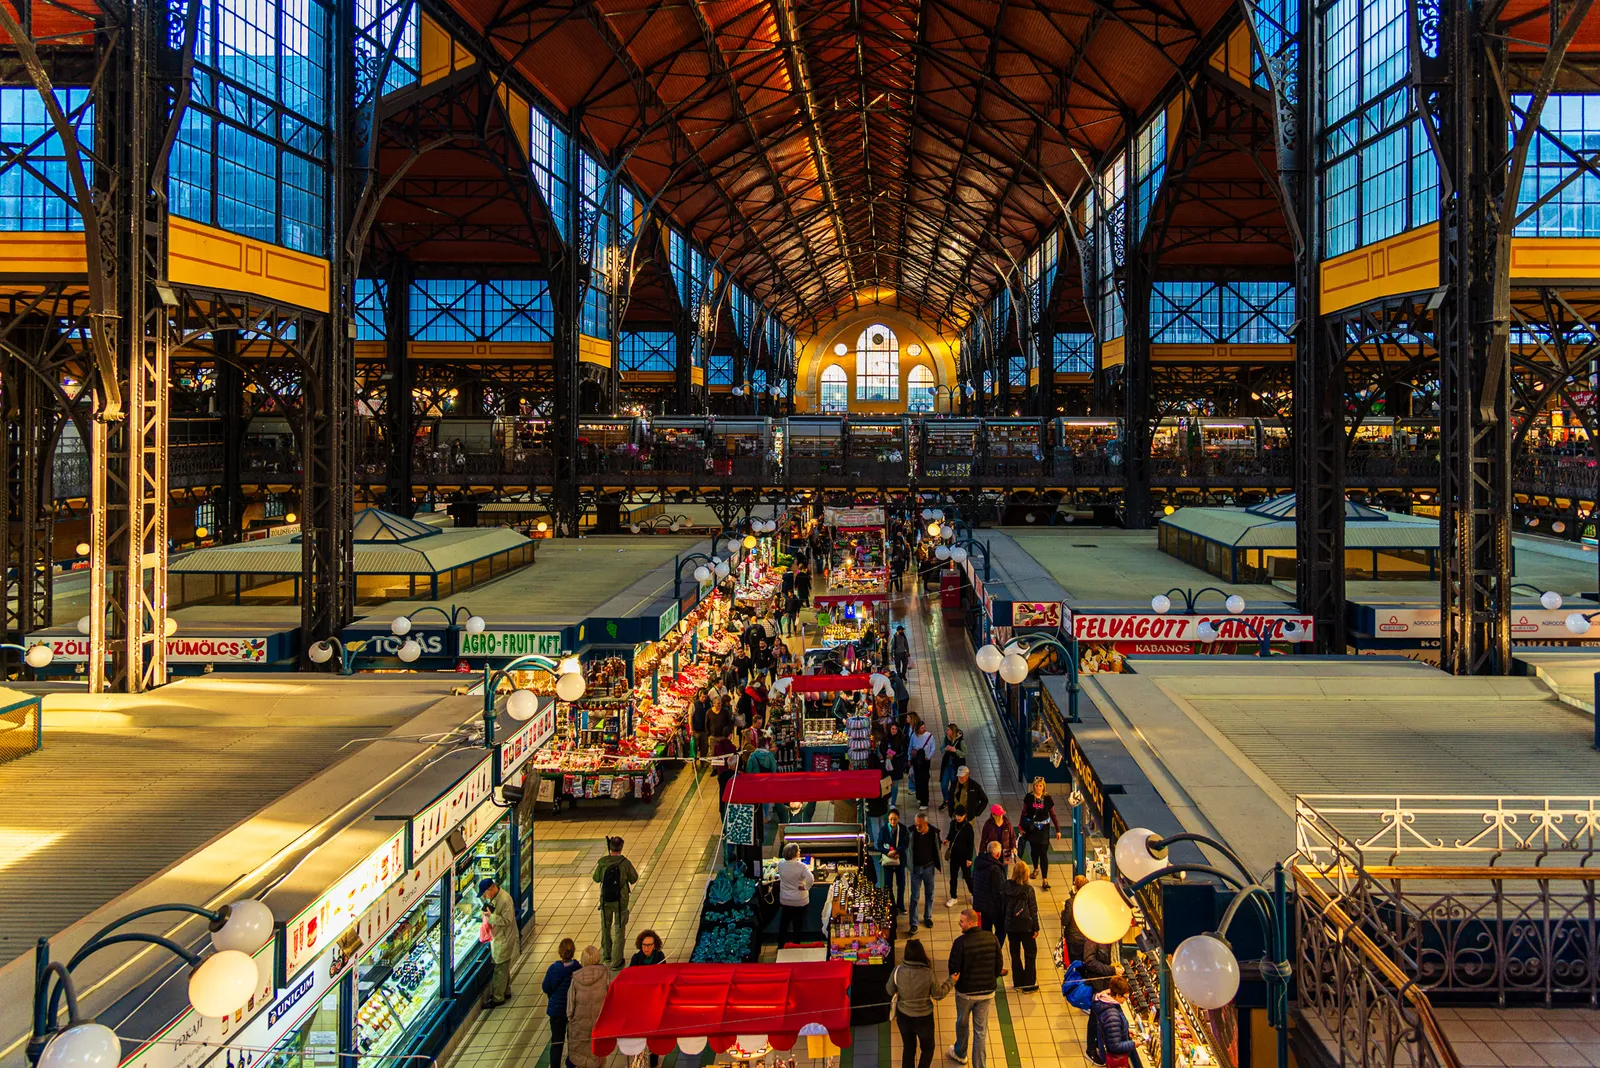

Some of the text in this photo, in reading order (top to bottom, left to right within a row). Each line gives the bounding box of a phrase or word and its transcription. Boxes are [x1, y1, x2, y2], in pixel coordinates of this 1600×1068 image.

[1075, 615, 1191, 639] FELVÁGOTT
[165, 639, 240, 656] YÜMÖLCS
[371, 632, 443, 654] TOÁS
[462, 633, 561, 655] AGRO-FRUIT KFT.
[1135, 643, 1191, 653] KABANOS
[277, 975, 314, 1016] UNICUM
